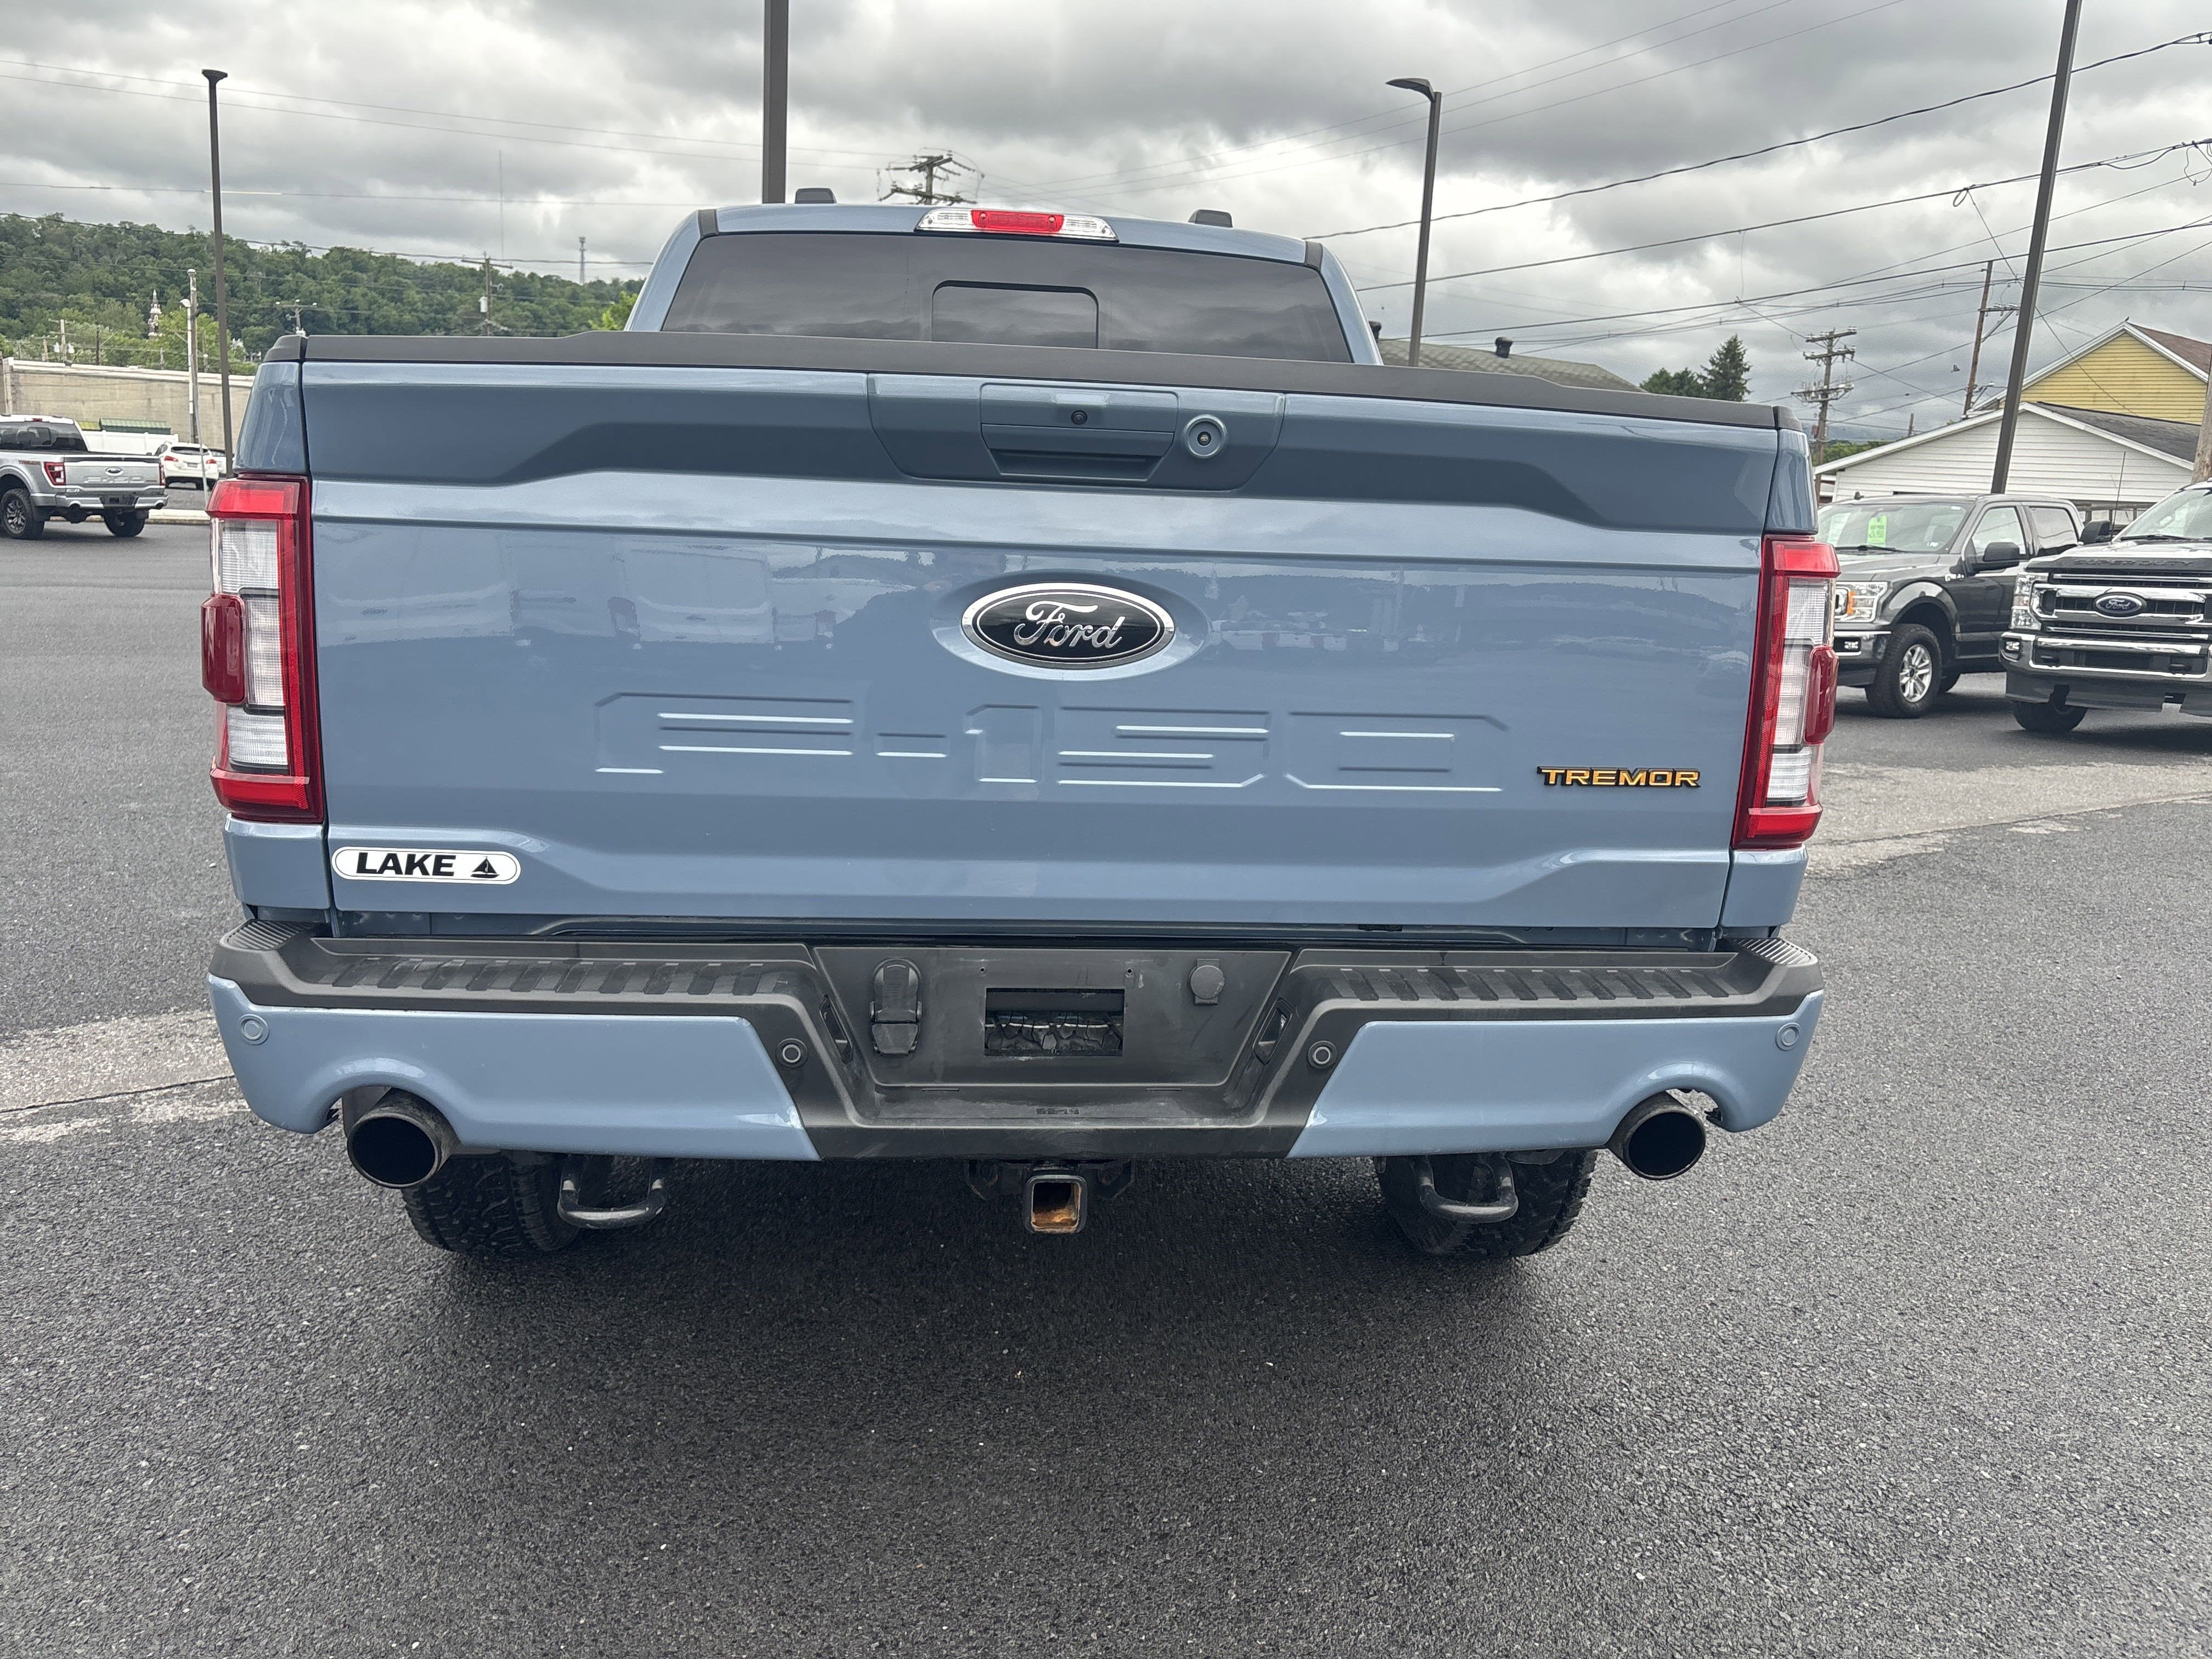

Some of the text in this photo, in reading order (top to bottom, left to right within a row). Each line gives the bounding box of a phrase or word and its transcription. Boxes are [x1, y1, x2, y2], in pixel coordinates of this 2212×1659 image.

[2106, 599, 2131, 610] Ford
[1013, 600, 1126, 649] Ford
[595, 692, 1510, 791] F-150
[1537, 766, 1701, 787] TREMOR
[356, 852, 456, 876] LAKE
